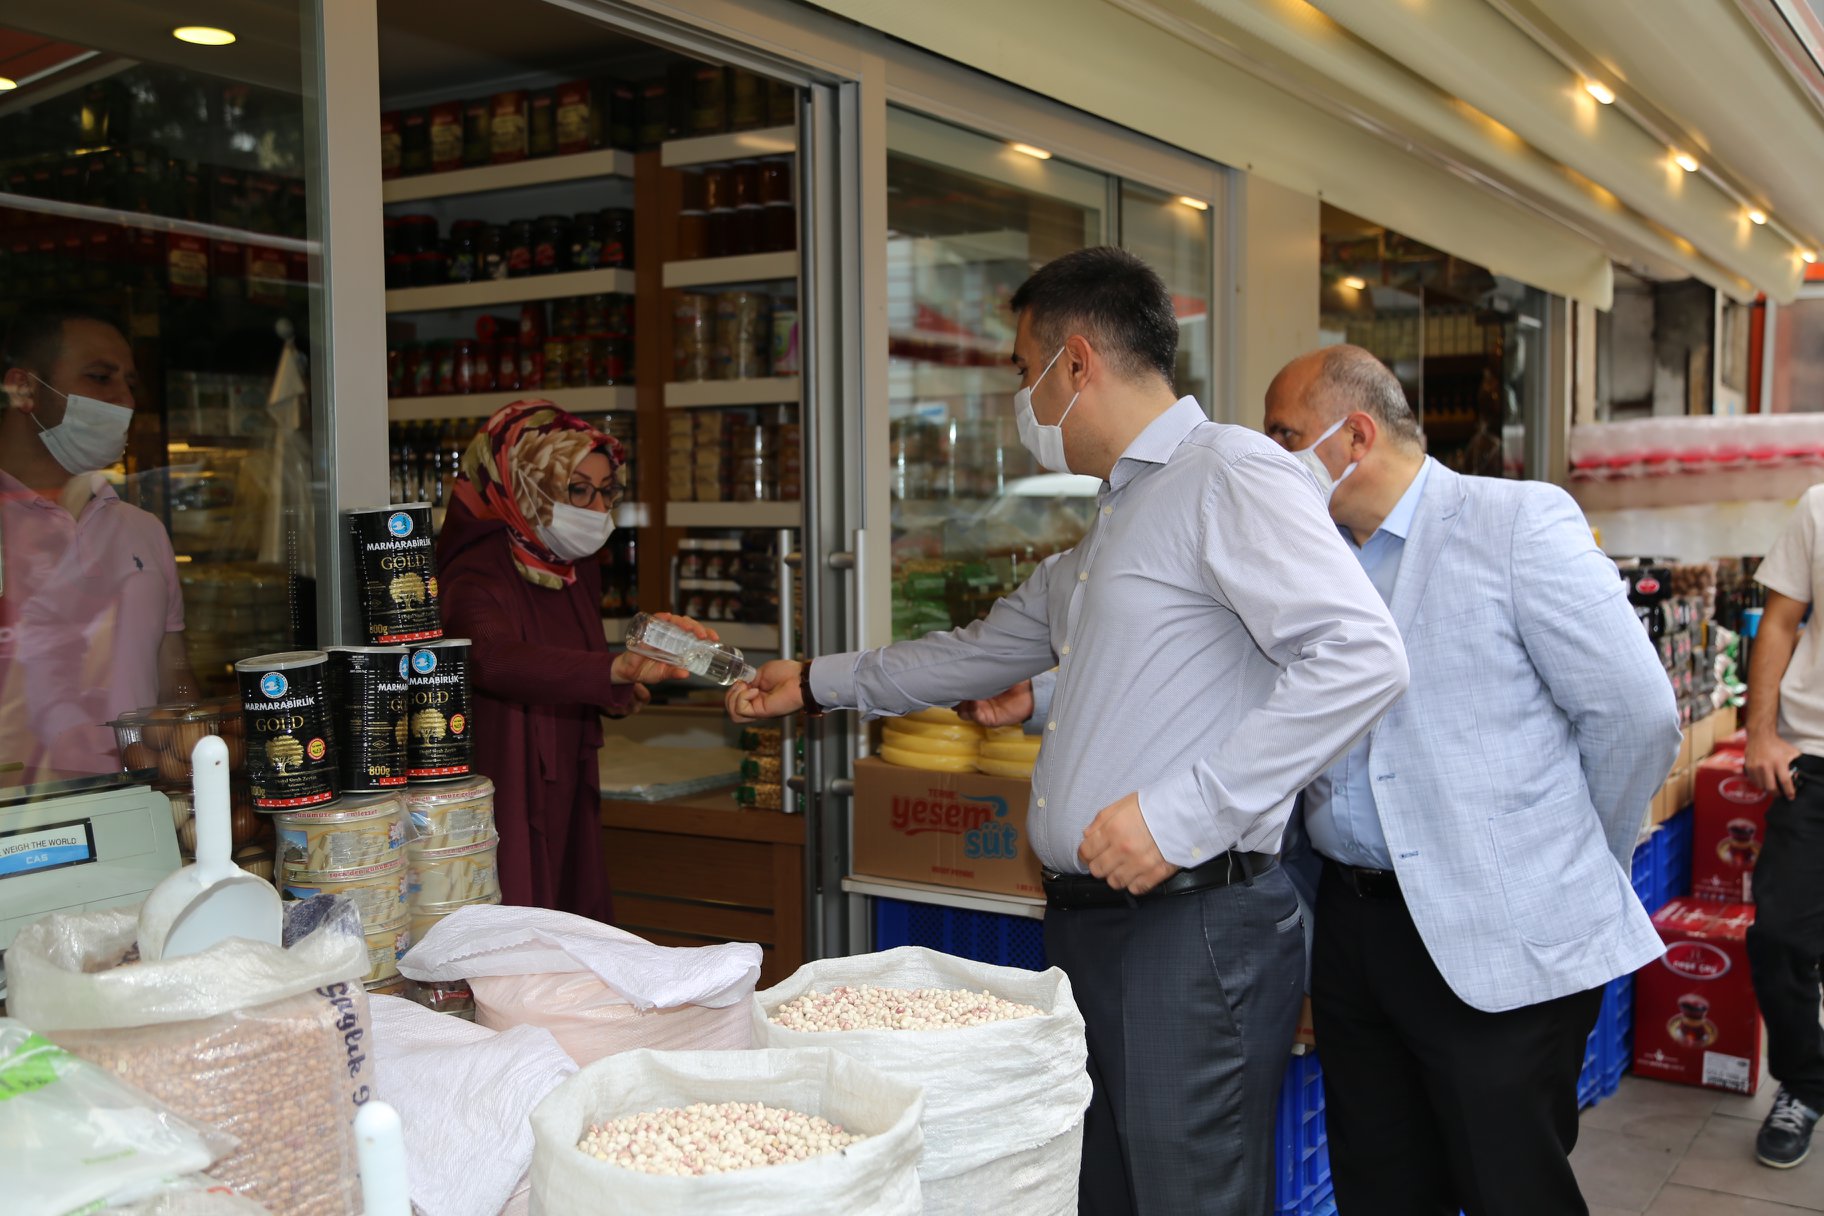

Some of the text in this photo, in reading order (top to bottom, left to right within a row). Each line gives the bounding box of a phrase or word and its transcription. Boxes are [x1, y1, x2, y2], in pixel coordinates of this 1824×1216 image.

[366, 536, 431, 551] MARMARABİRLİK
[381, 554, 426, 570] GOLD
[244, 695, 315, 710] MARMARABİRLİK
[256, 715, 304, 731] GOLD
[369, 765, 391, 777] 800g
[891, 796, 993, 830] yesem
[2, 837, 77, 855] WEIGH THE WORLD
[964, 822, 1018, 859] süt
[26, 854, 49, 864] CAS
